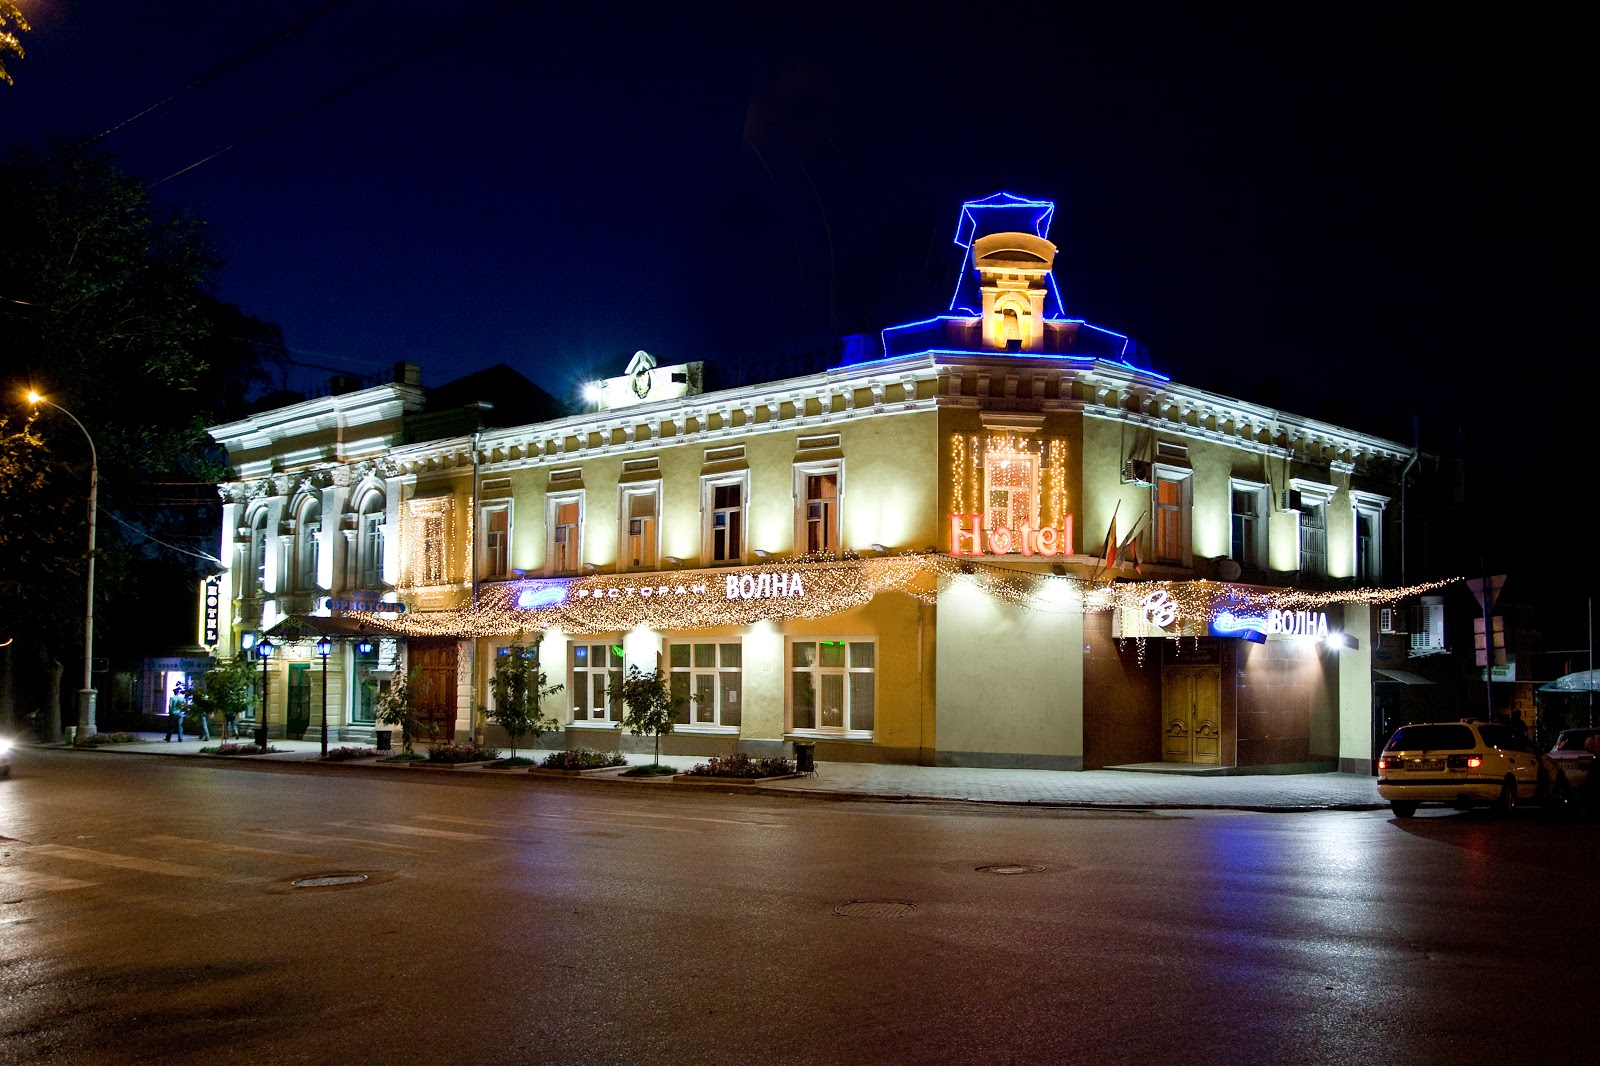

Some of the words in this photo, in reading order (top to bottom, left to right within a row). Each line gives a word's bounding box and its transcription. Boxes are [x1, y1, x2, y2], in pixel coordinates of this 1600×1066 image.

[947, 513, 1075, 557] Hotel
[577, 584, 706, 599] РЕСТОРАН
[725, 572, 805, 600] ВОЛНА
[206, 585, 218, 640] HOTEL
[331, 600, 402, 613] БРИСТОЛЬ
[1268, 609, 1330, 637] ВОЛНА
